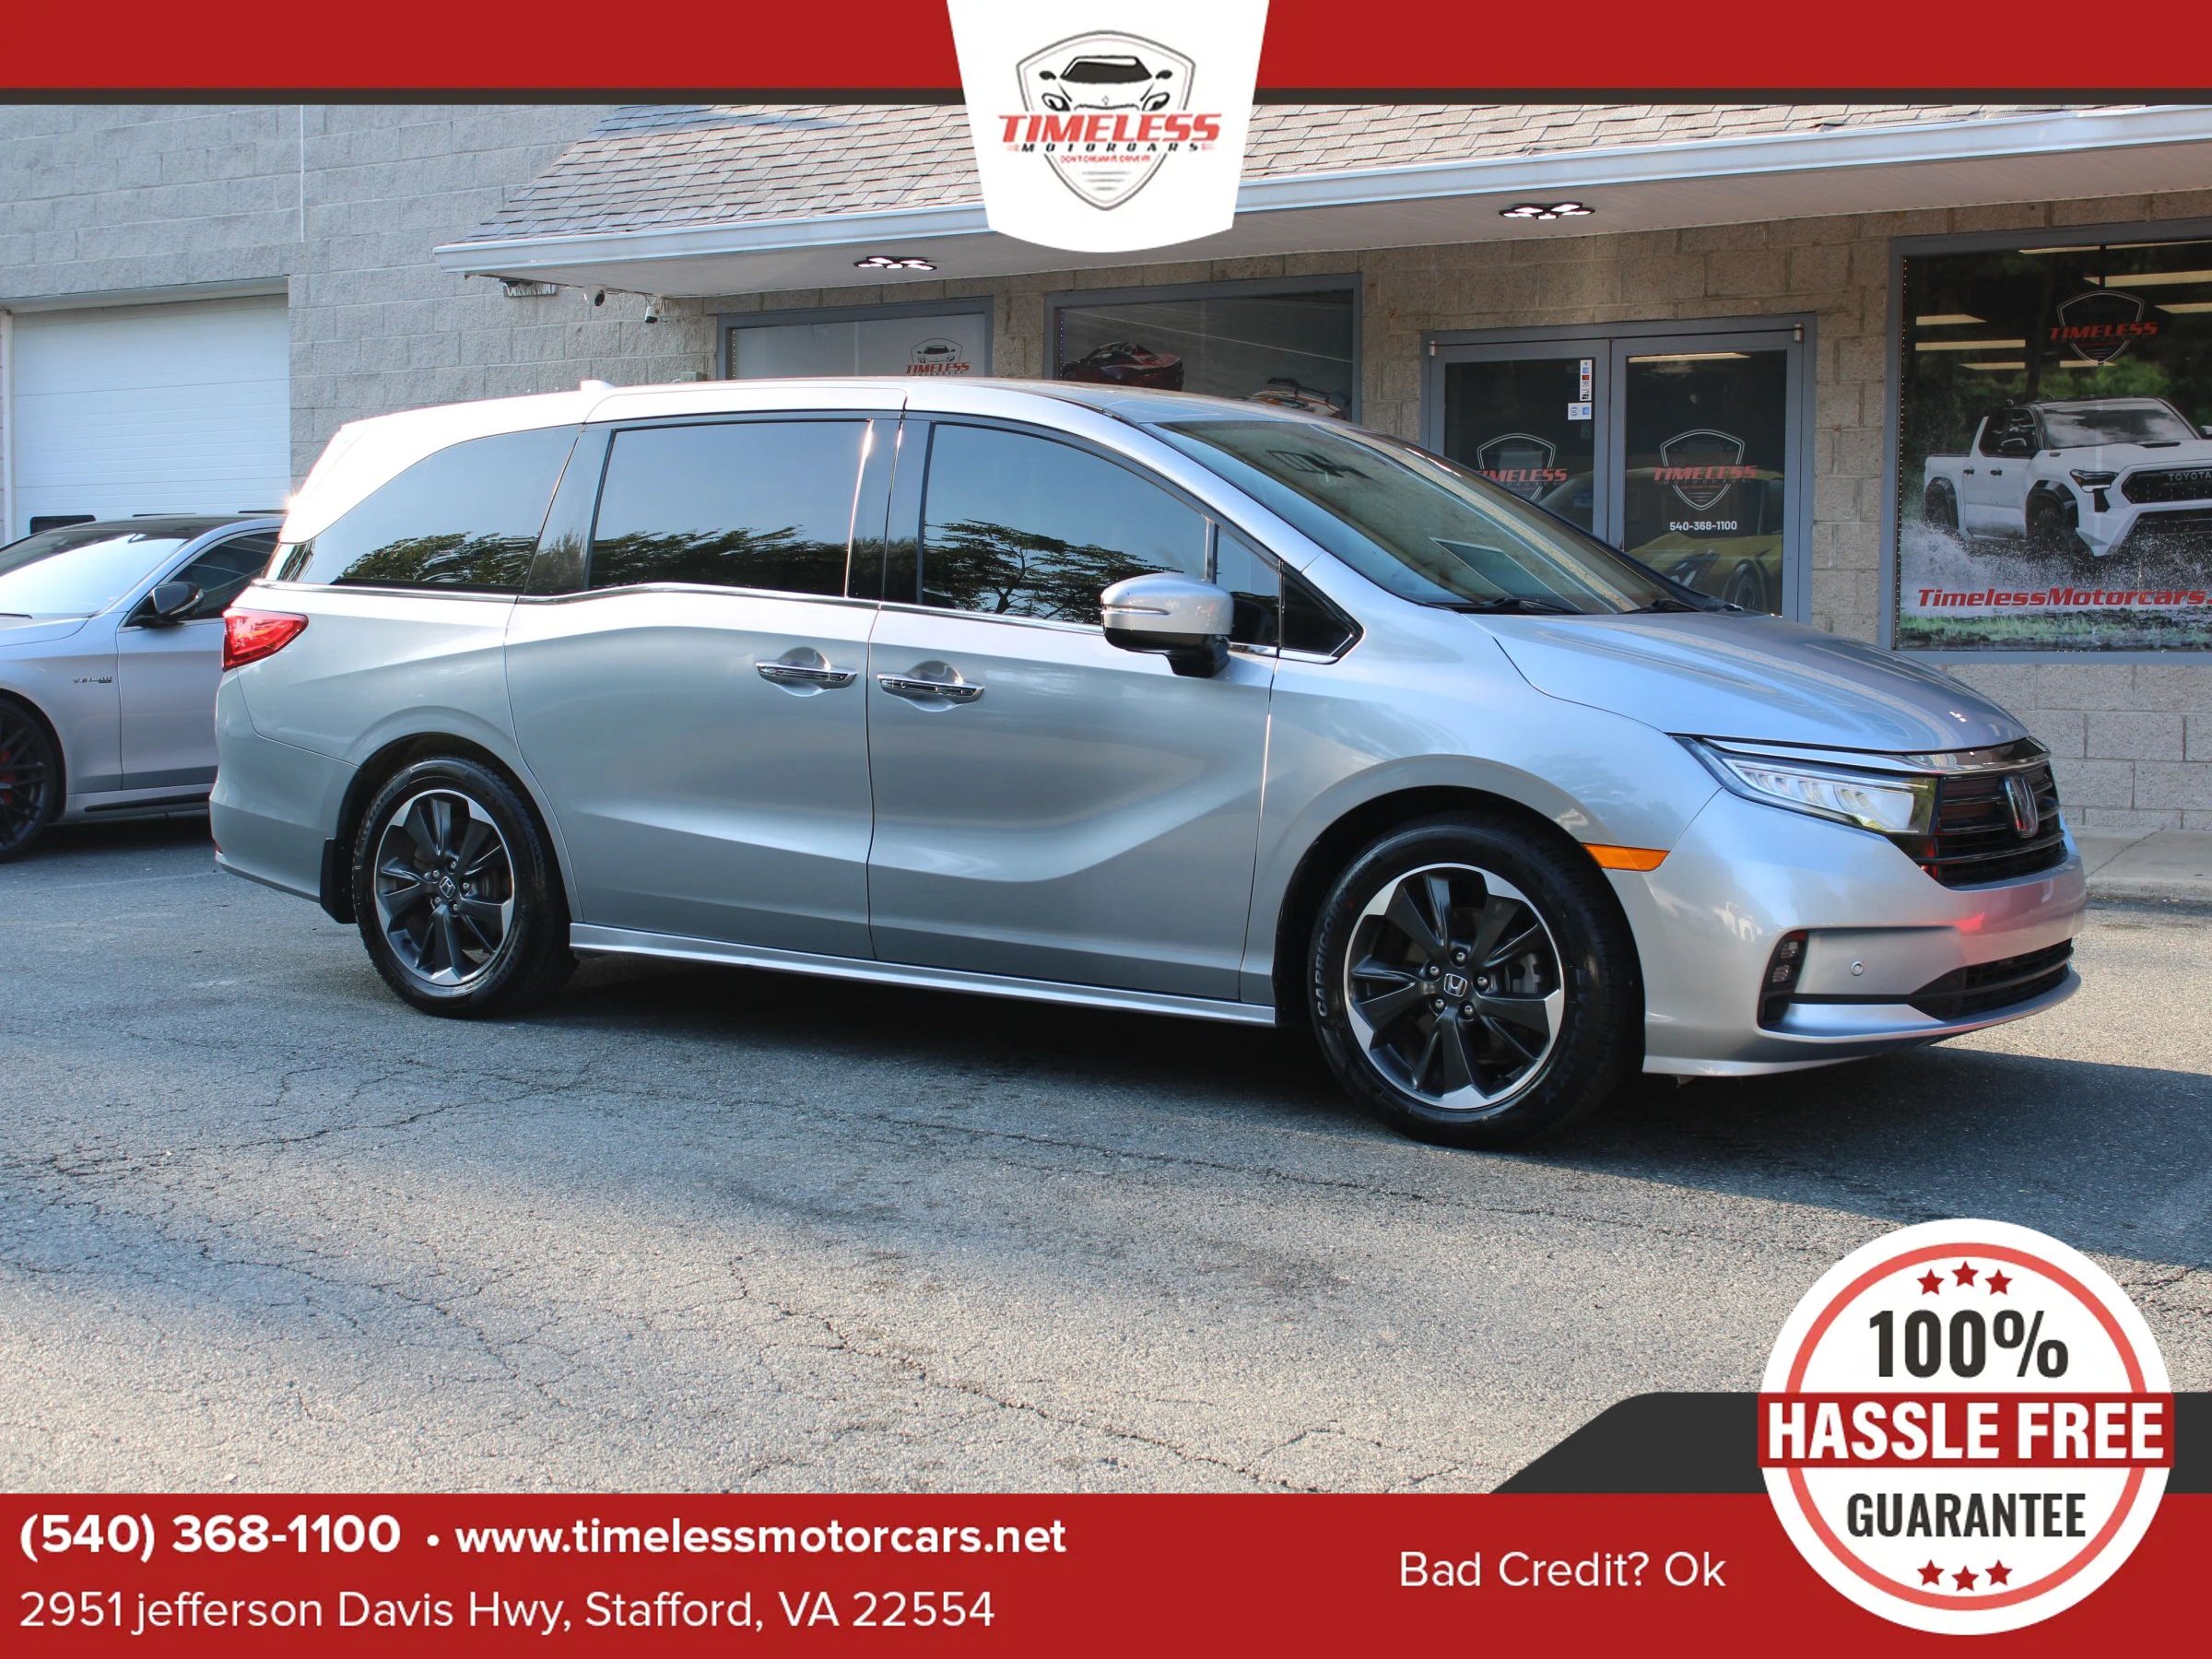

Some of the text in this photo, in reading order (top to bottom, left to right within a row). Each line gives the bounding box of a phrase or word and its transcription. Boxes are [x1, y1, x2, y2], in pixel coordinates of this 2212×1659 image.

[2050, 322, 2159, 340] TIMELESS
[906, 362, 971, 373] TIMELESS
[1475, 468, 1568, 482] MELESS
[1653, 465, 1758, 480] TIMELESS
[2168, 471, 2212, 481] TOYOTA
[1669, 521, 1737, 531] 540-368-1100
